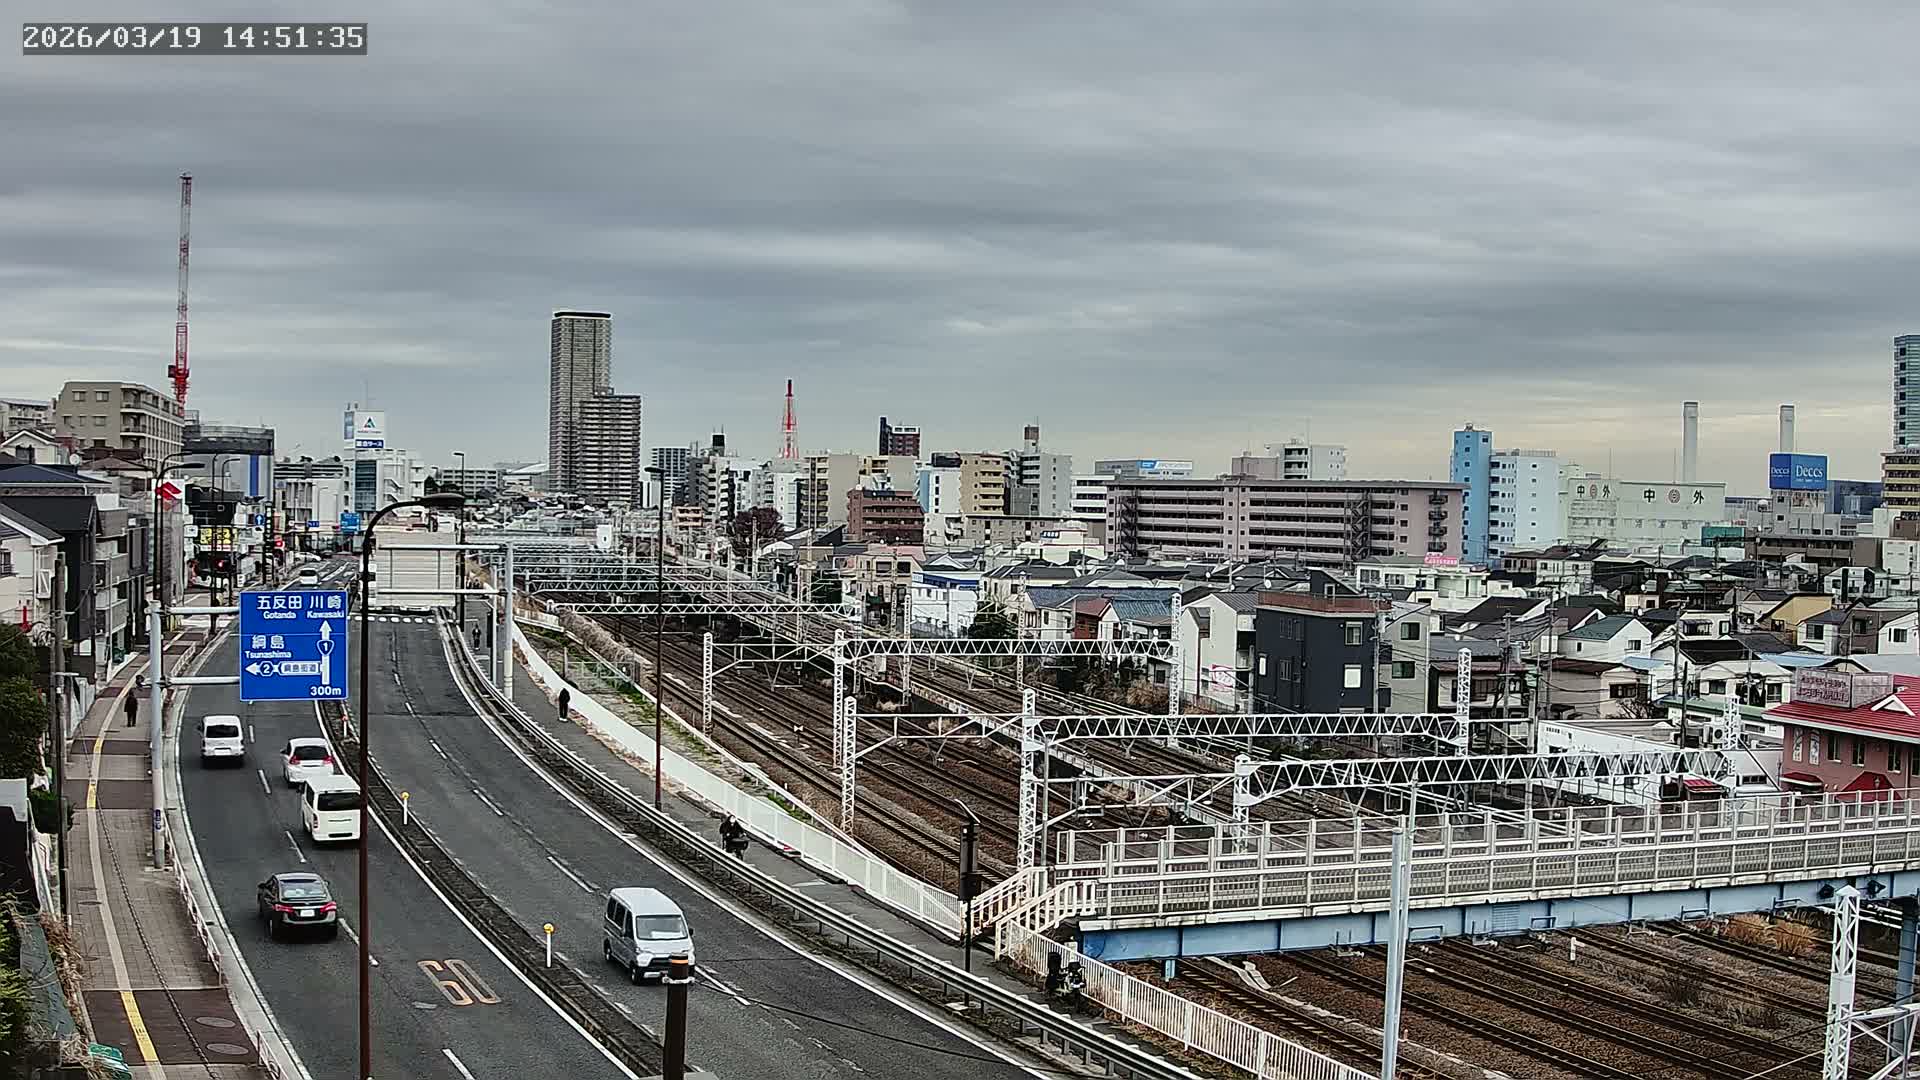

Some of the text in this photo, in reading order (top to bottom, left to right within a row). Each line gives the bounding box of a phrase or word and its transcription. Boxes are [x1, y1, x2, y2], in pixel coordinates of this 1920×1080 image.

[257, 595, 342, 610] 五反田 川崎
[263, 610, 344, 619] Gotanda Kawasaki
[322, 642, 329, 652] 1
[245, 650, 292, 659] Tsunashima
[263, 664, 270, 674] 2
[310, 686, 342, 696] 300m
[417, 959, 501, 1006] 60
